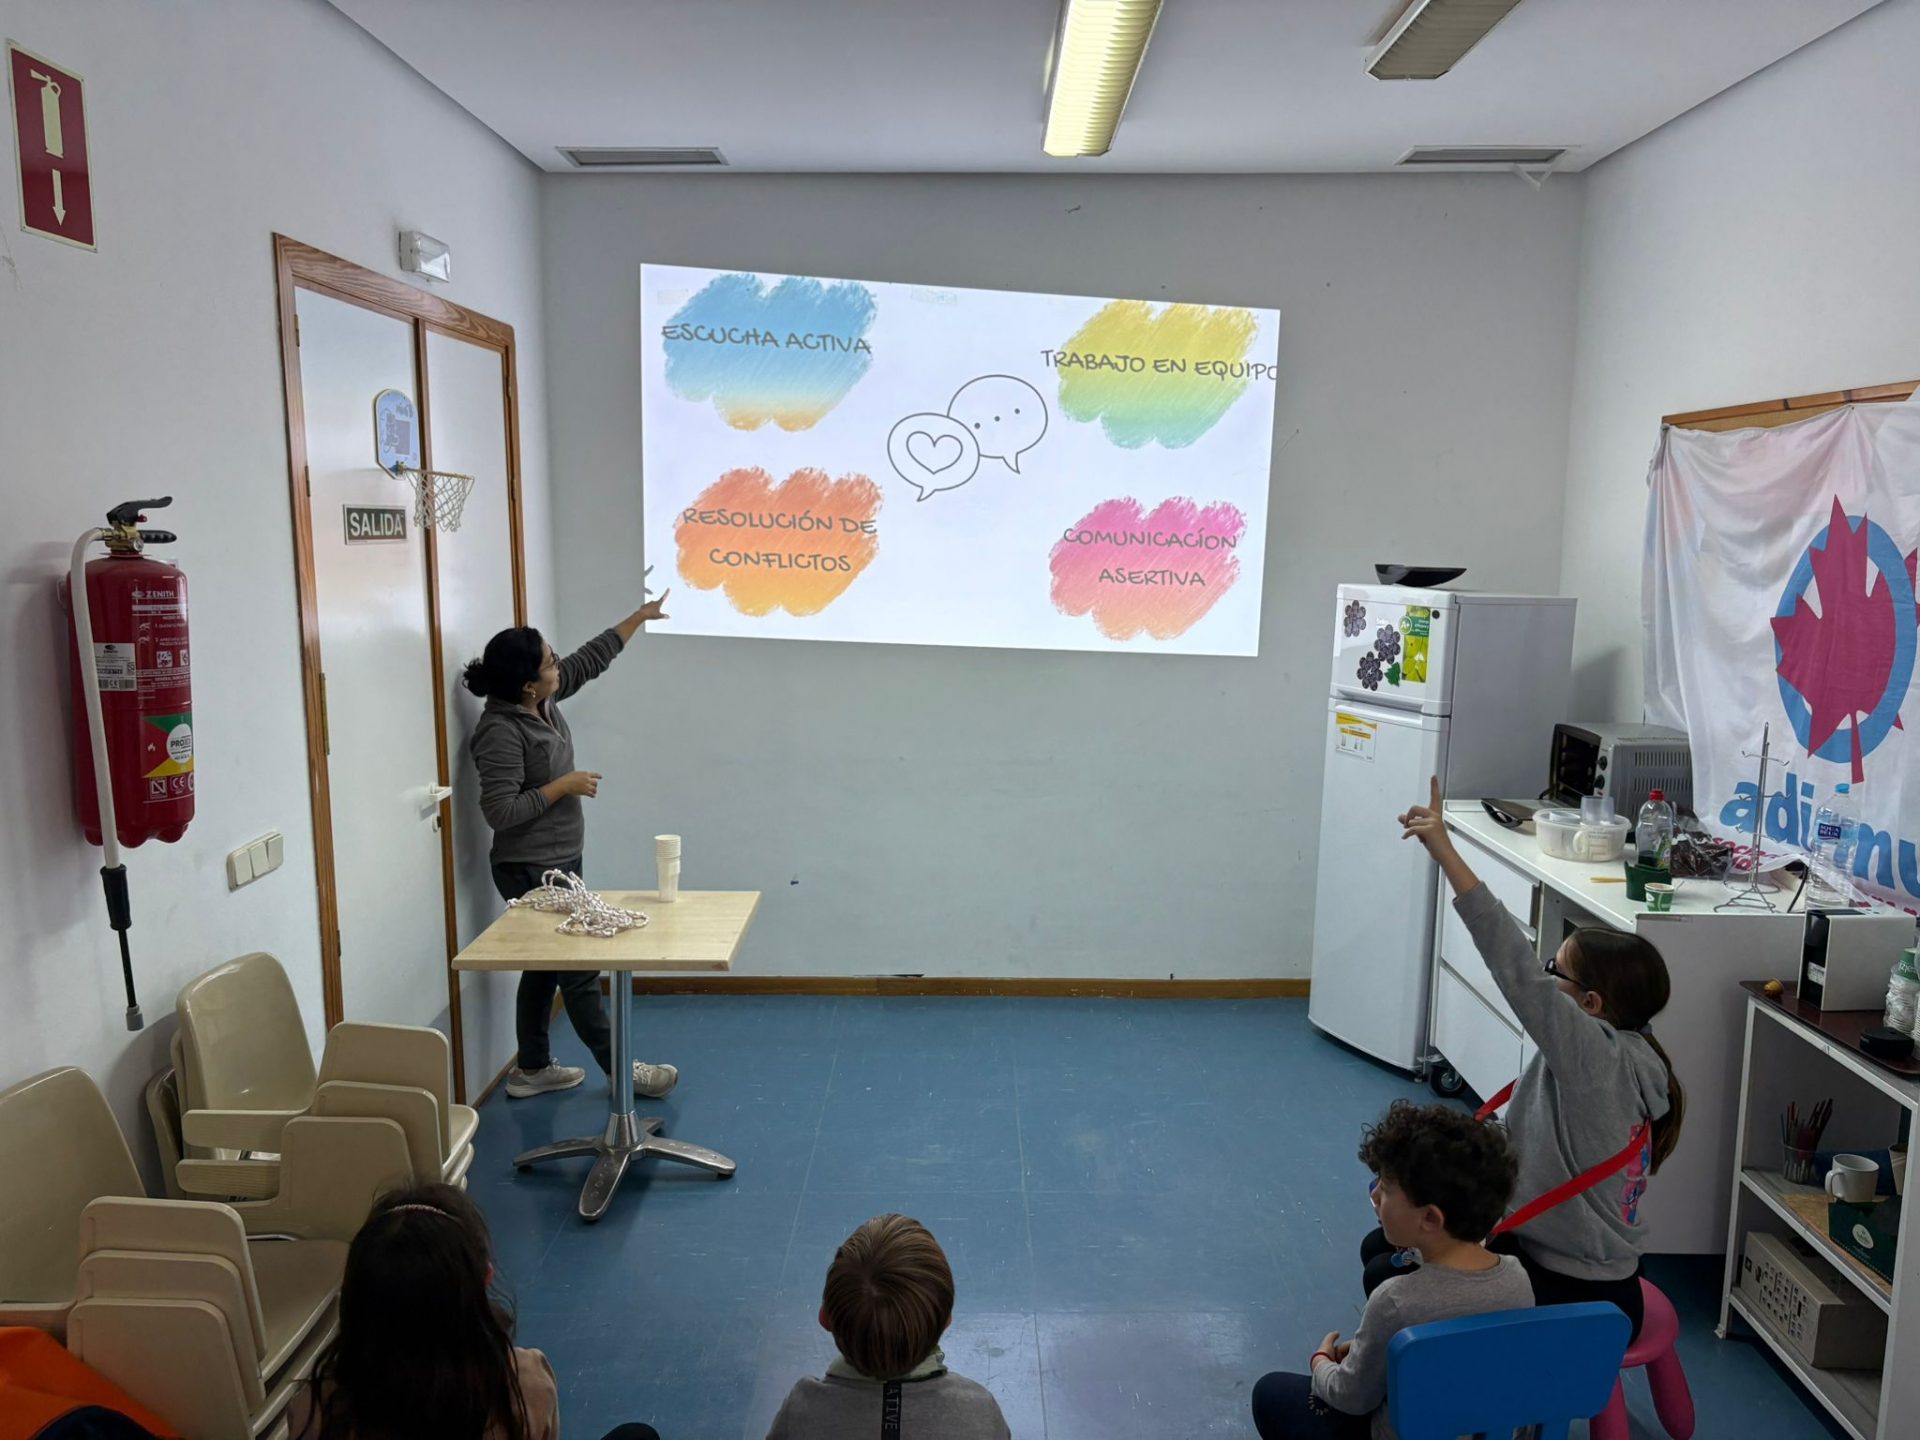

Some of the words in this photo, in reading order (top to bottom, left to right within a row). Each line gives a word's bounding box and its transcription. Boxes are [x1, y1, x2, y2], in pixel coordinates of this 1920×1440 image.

[661, 323, 780, 347] ESCUCHA
[785, 332, 873, 355] ACTIVA
[1040, 349, 1146, 373] TRABAJO
[1152, 358, 1187, 374] EN
[349, 512, 405, 537] SALIDA
[683, 508, 833, 532] RESOLUCIÓN
[838, 517, 878, 535] DE
[709, 548, 852, 572] CONFLICTOS
[1099, 567, 1206, 587] ASERTIVA
